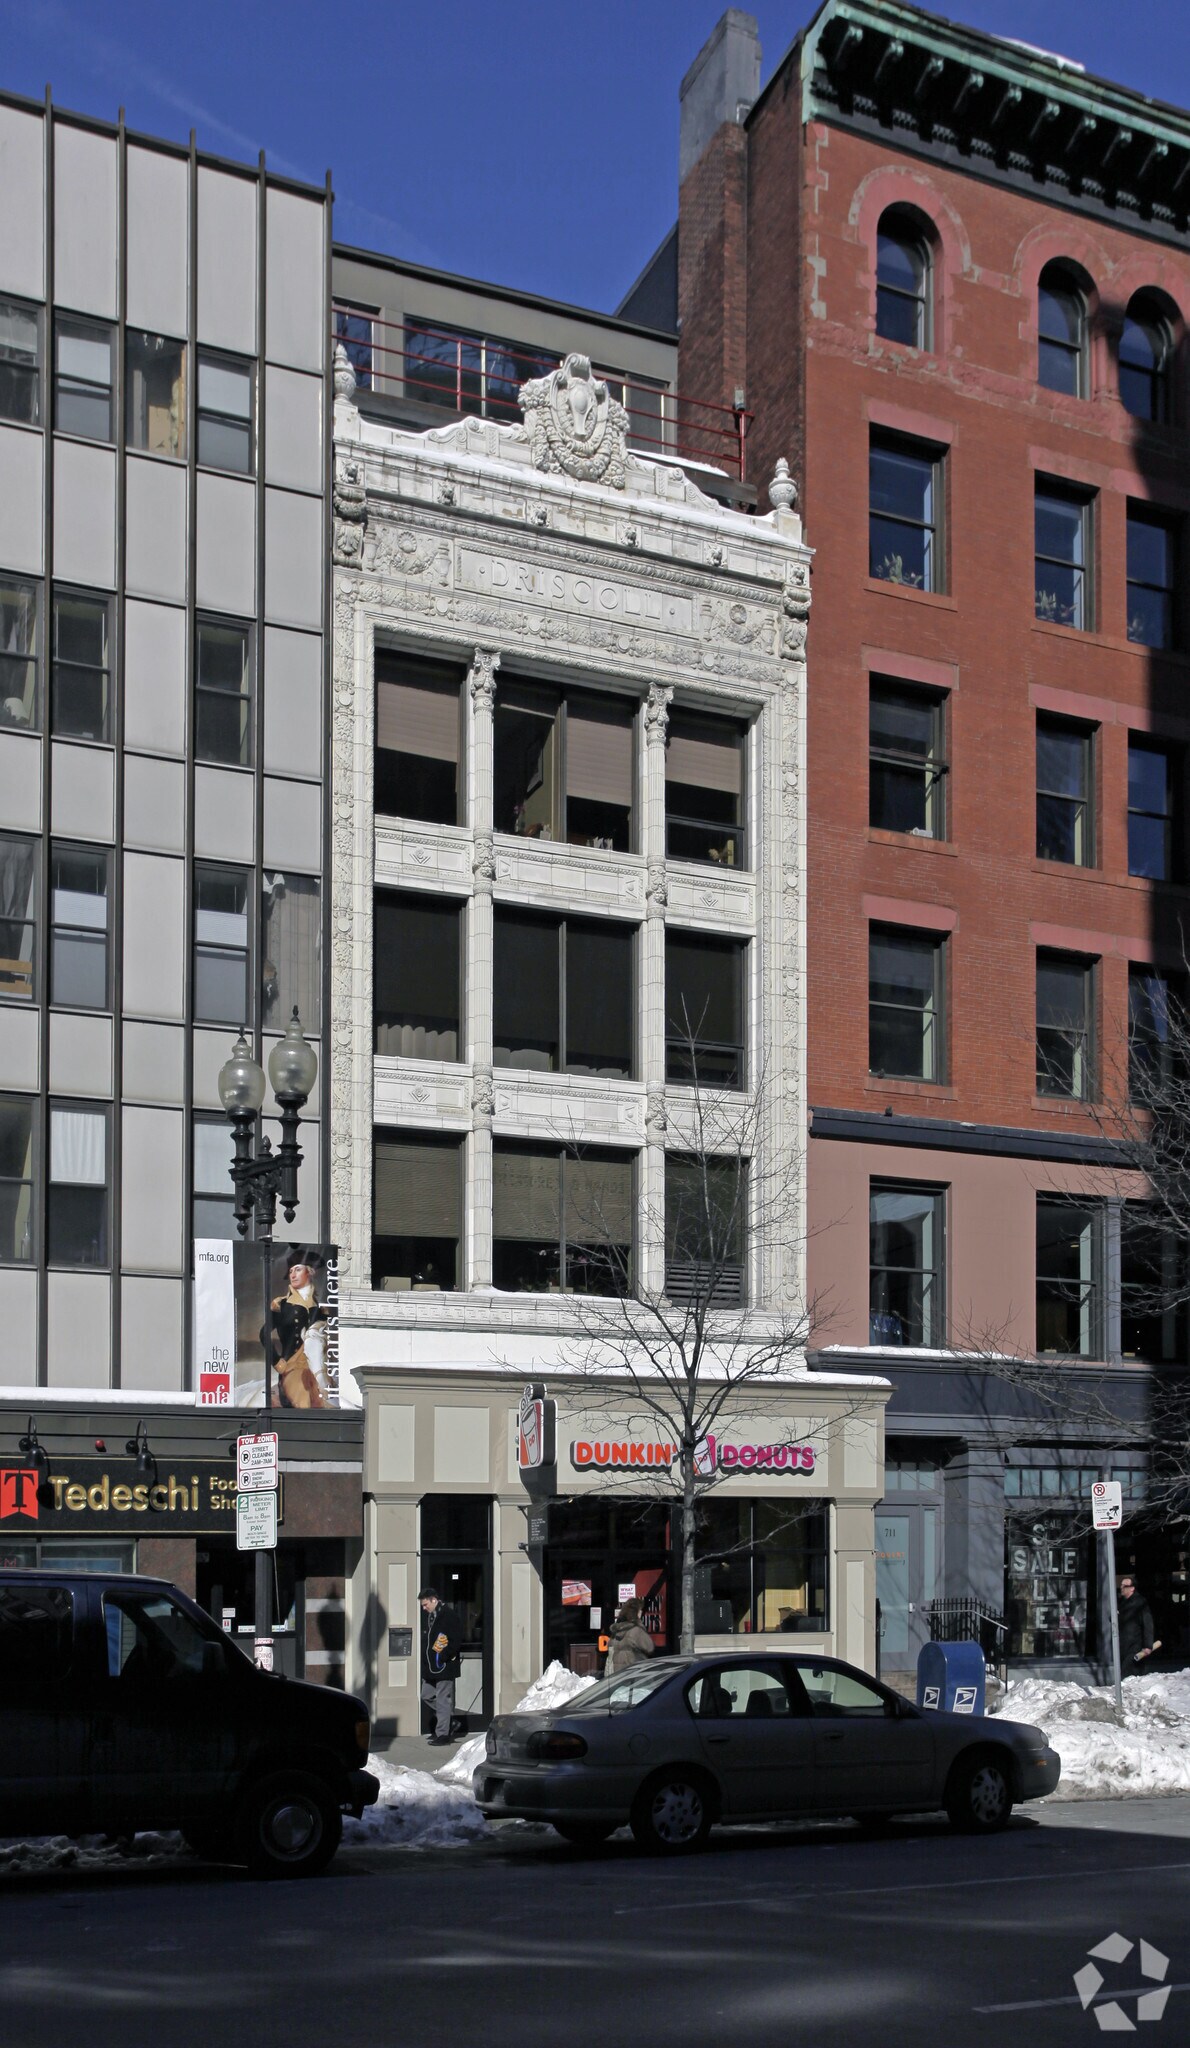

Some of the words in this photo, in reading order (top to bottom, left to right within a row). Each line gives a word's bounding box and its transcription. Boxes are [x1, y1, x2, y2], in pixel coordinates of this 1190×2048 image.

[491, 559, 661, 620] DRISCOLL
[198, 1252, 230, 1264] mfa.org
[318, 1259, 339, 1308] here
[211, 1346, 229, 1360] the
[323, 1316, 339, 1379] starts
[203, 1361, 229, 1373] new
[200, 1384, 229, 1404] mfa
[318, 1385, 339, 1400] it
[257, 1435, 274, 1443] ZONE
[576, 1441, 678, 1464] DUNKIN'
[722, 1444, 815, 1469] DONUTS
[209, 1476, 238, 1491] Foo
[47, 1474, 199, 1511] Tedeschi
[210, 1495, 237, 1510] Sho
[240, 1496, 248, 1507] 2
[884, 1528, 896, 1537] 711
[1013, 1549, 1076, 1573] SALE
